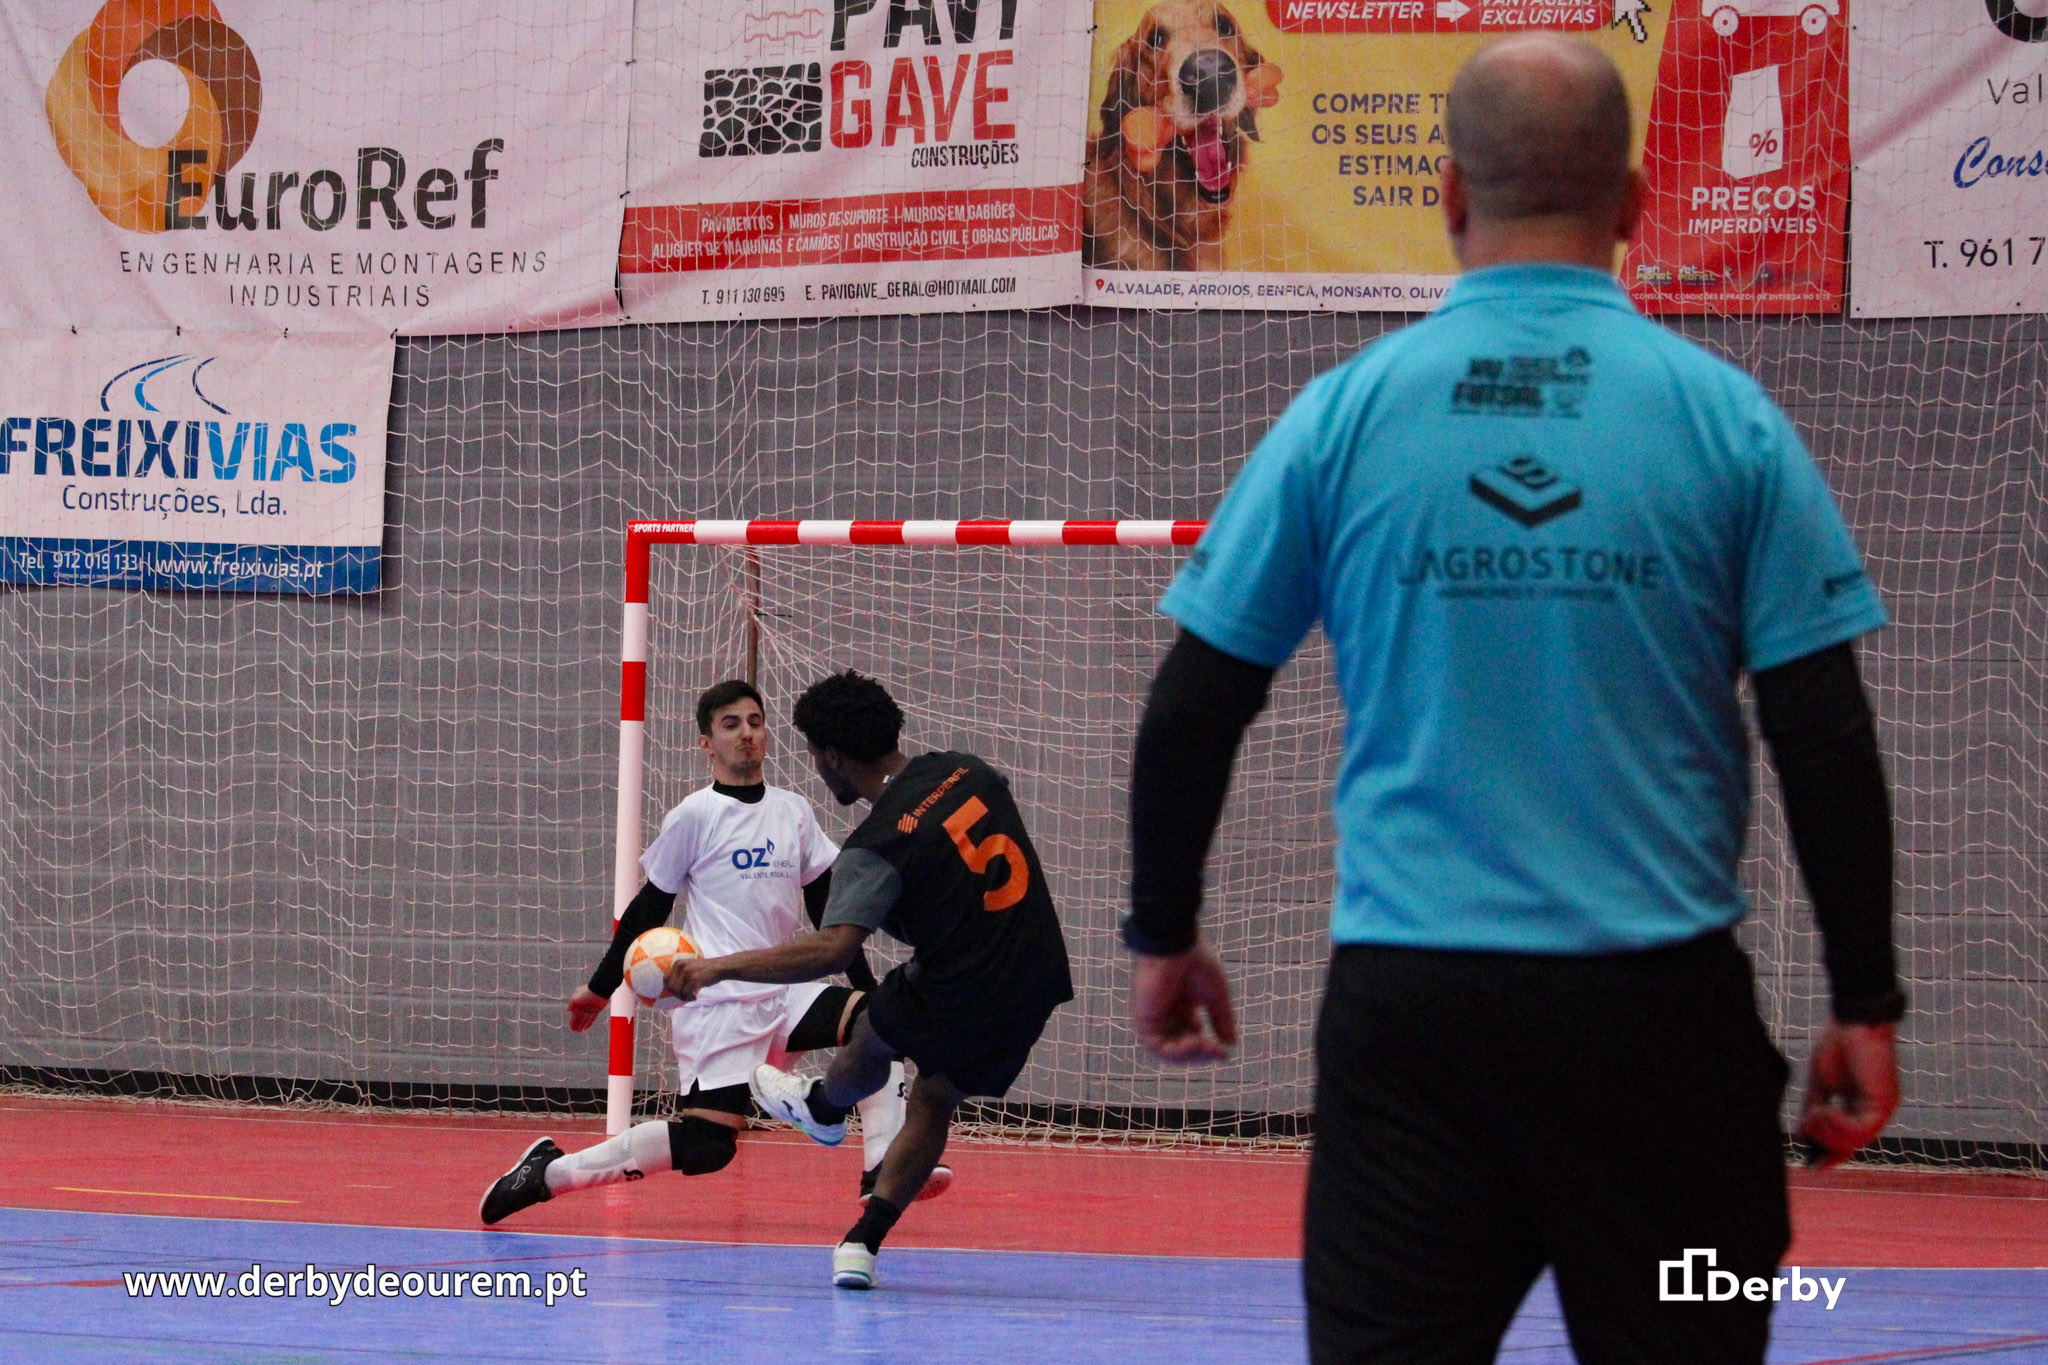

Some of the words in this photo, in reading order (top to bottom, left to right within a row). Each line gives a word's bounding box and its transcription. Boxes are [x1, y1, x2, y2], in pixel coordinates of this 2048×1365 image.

[1286, 2, 1424, 20] NEWSLETTER
[1481, 8, 1596, 25] EXCLUSIVAS
[829, 49, 1016, 149] GAVE
[1312, 93, 1420, 114] COMPRE
[1312, 124, 1346, 144] OS
[1355, 124, 1418, 144] SEUS
[911, 141, 1019, 169] CONSTRUÇÕES
[1954, 136, 2048, 189] Cons
[164, 137, 505, 232] EuroRef
[1353, 185, 1413, 206] SAIR
[1691, 185, 1816, 213] PREÇOS
[702, 215, 775, 233] PAVIMENTOS
[789, 213, 826, 229] MUROS
[828, 211, 842, 227] DE
[843, 208, 889, 226] SUPORTE
[904, 206, 946, 223] MUROS
[948, 205, 966, 221] EM
[968, 201, 1016, 221] GABIÕES
[1688, 213, 1818, 235] IMPERDÍVEIS
[652, 242, 703, 260] ALUGUER
[706, 241, 721, 256] DE
[724, 236, 783, 256] MÁQUINAS
[787, 238, 794, 253] E
[796, 232, 840, 251] CAMIÕES
[854, 227, 928, 250] CONSTRUÇÃO
[931, 229, 960, 246] CIVIL
[962, 229, 969, 245] E
[972, 226, 1010, 245] OBRAS
[1011, 223, 1060, 243] PÚBLICAS
[1923, 239, 1948, 269] T.
[1960, 238, 2013, 268] 961
[120, 250, 315, 275] ENGENHARIA
[331, 252, 345, 275] E
[355, 250, 548, 275] MONTAGENS
[229, 284, 431, 307] INDUSTRIAIS
[702, 289, 710, 305] T.
[742, 287, 761, 303] 130
[1105, 282, 1184, 297] ALVALADE,
[1257, 284, 1318, 299] BENFICA,
[0, 416, 358, 484] FREIXIVIAS
[63, 484, 226, 519] Construções,
[236, 490, 288, 516] Lda.
[633, 523, 661, 533] SPORTS
[662, 522, 694, 533] PARTNER
[53, 552, 81, 569] 912
[85, 553, 111, 570] 019
[156, 556, 324, 582] www.freixivias.pt
[912, 766, 970, 817] INTERPERFIL
[731, 847, 770, 870] OZ
[942, 795, 1029, 912] 5
